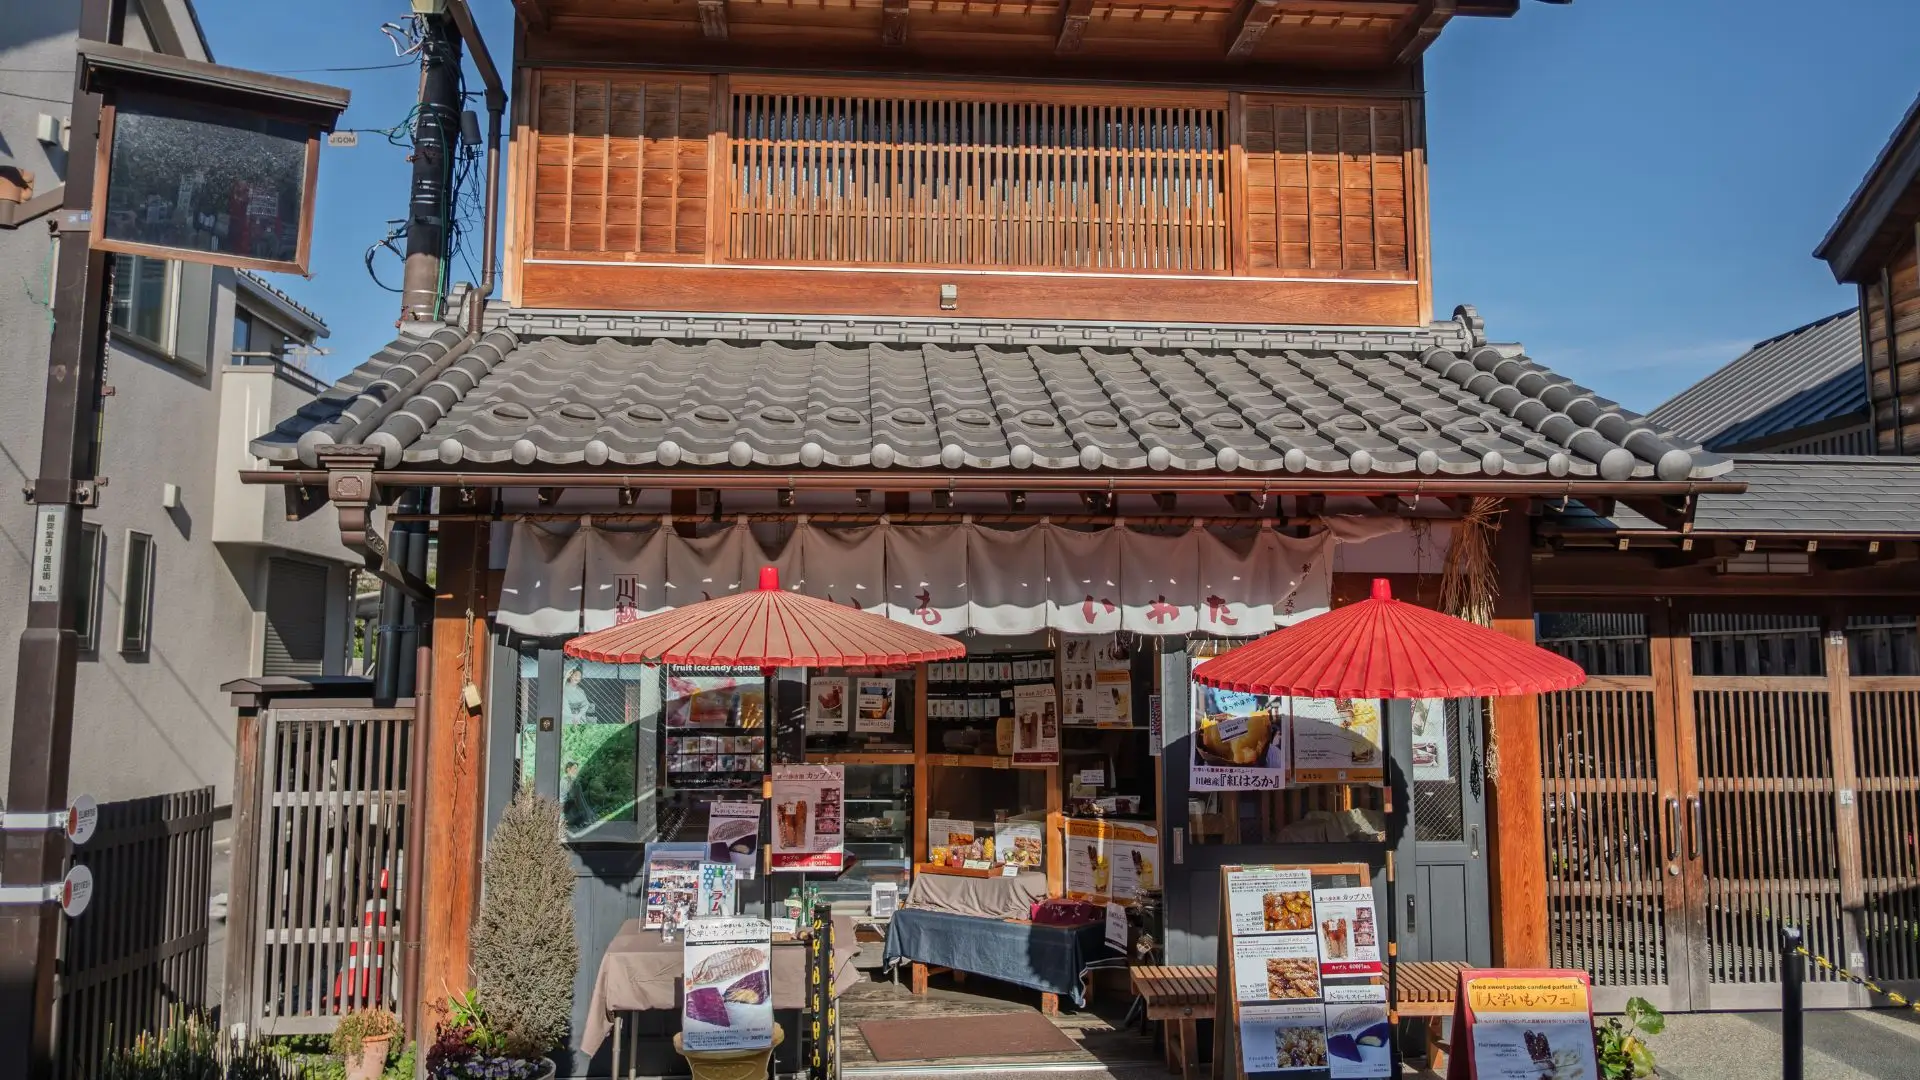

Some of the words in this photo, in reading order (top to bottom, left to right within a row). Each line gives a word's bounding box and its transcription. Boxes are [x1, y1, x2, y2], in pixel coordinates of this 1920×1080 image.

[1476, 991, 1577, 1007] 『大学いもパフェ』
